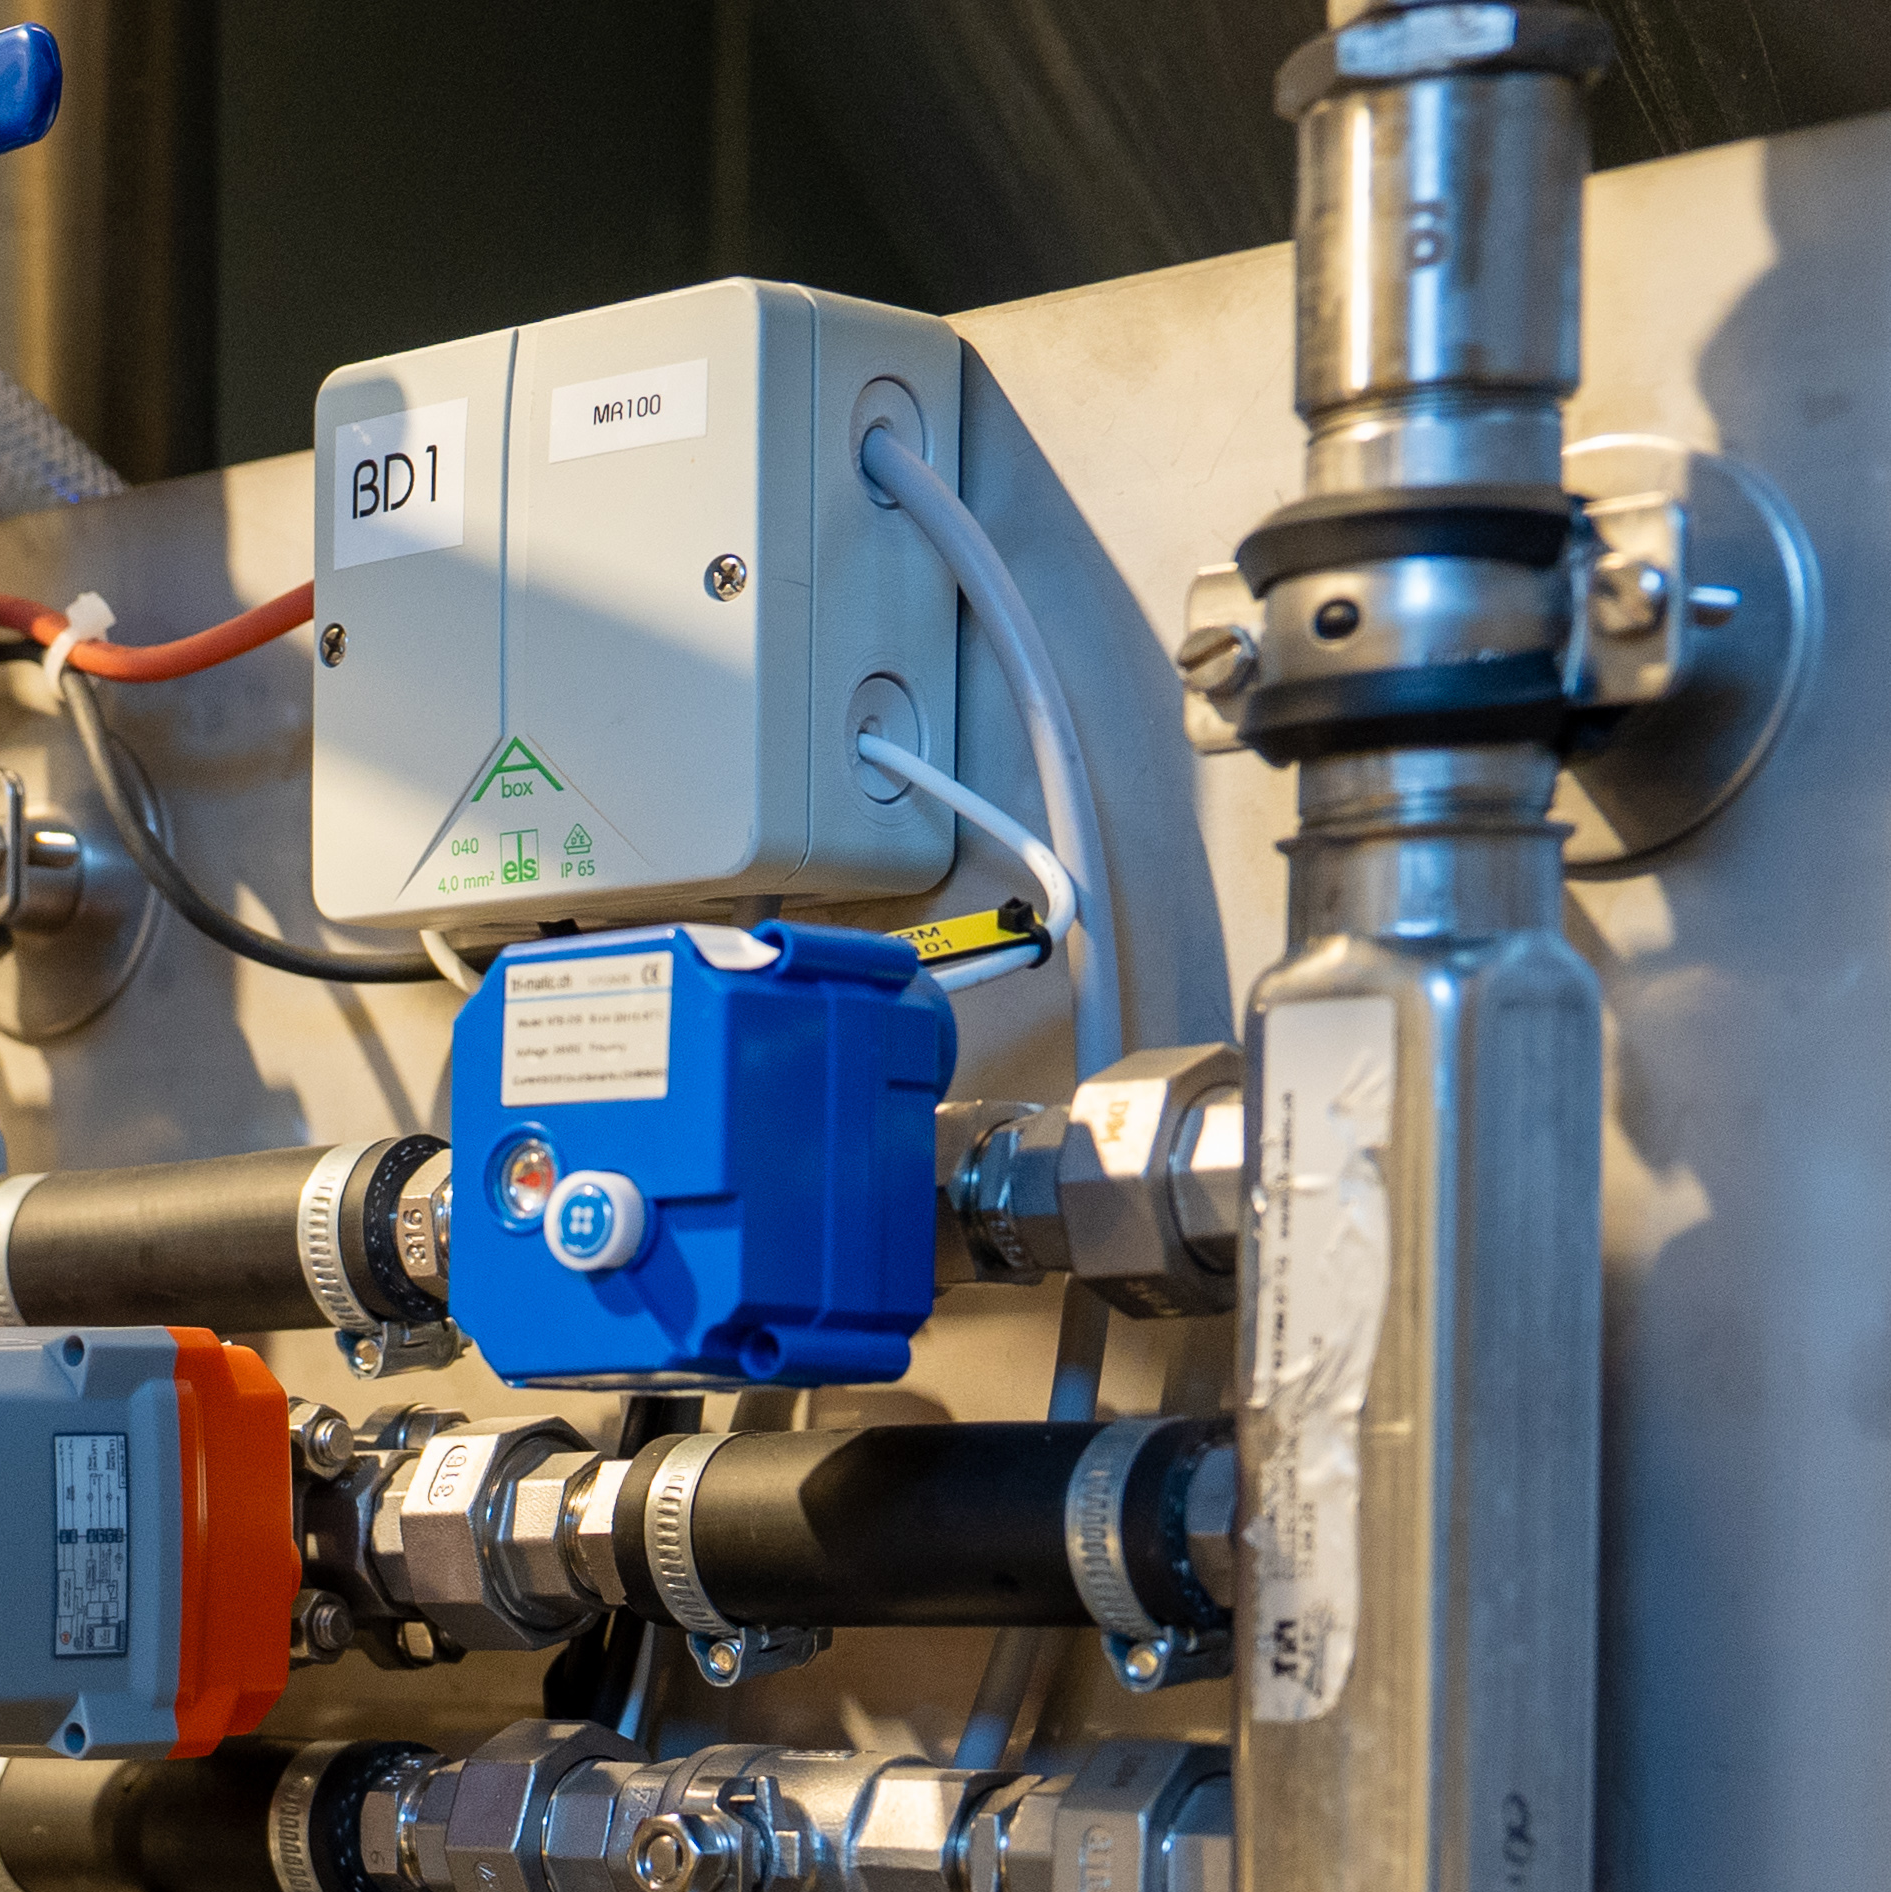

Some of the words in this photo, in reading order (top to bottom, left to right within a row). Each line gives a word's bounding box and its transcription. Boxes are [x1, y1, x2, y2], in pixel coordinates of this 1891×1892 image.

[593, 394, 661, 425] MR100
[352, 445, 437, 519] BD1
[501, 776, 534, 798] box
[451, 837, 479, 857] 040
[503, 833, 537, 883] els
[560, 862, 573, 878] IP
[577, 859, 596, 877] 65
[438, 875, 459, 894] 4,0
[403, 1208, 426, 1265] 316
[434, 1454, 467, 1498] 316
